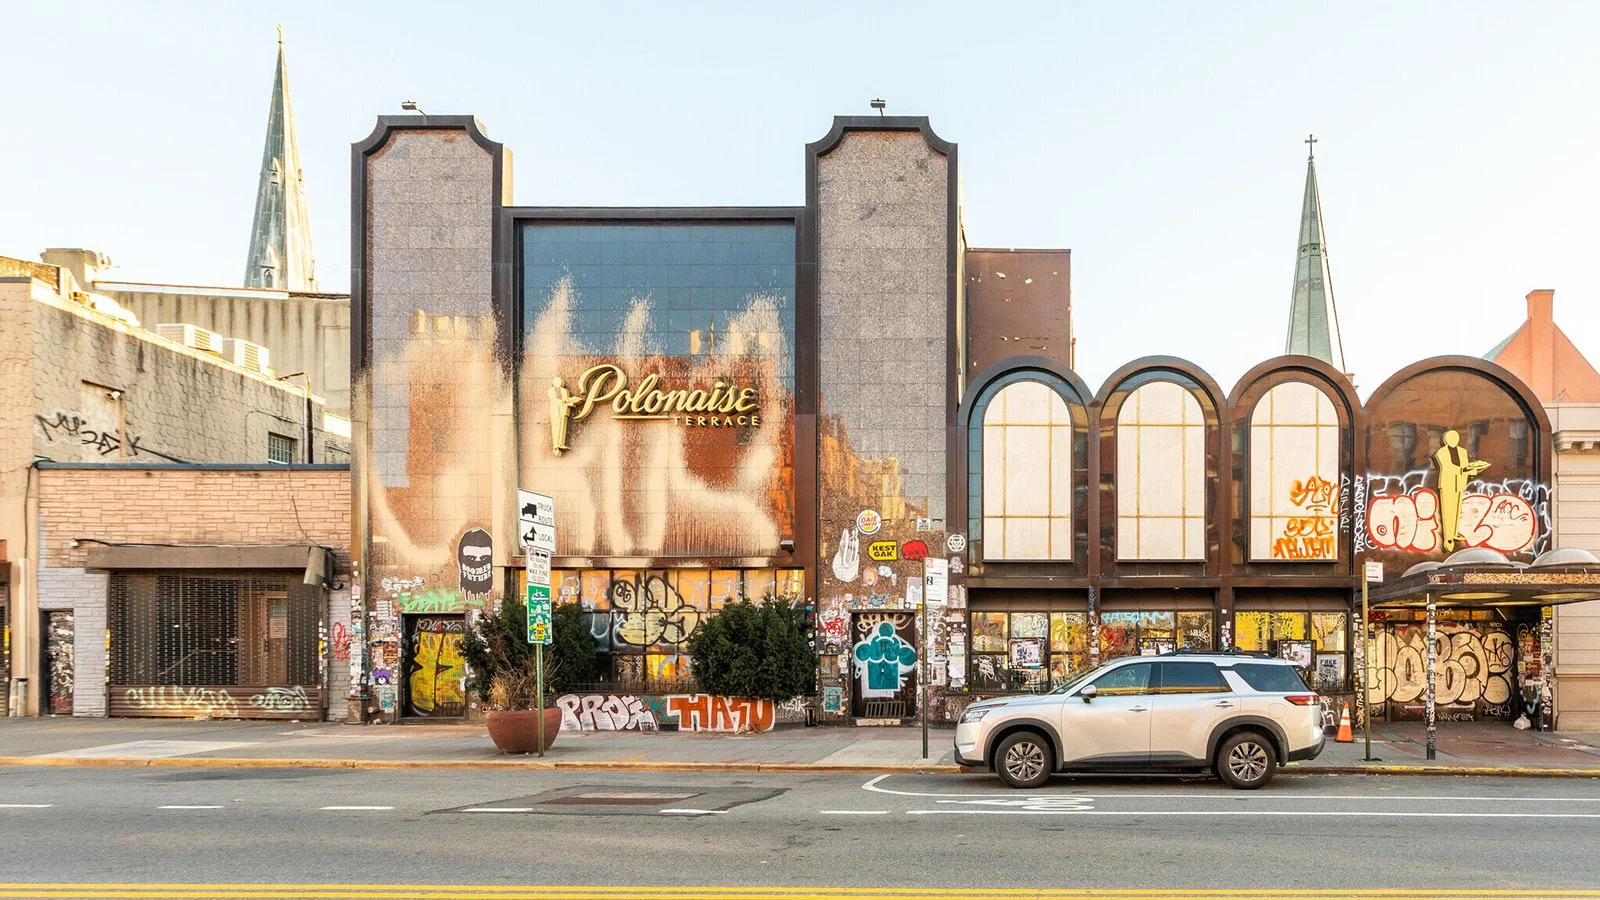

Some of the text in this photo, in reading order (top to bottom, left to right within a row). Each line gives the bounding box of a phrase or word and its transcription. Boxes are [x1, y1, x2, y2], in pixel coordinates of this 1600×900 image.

[573, 364, 761, 421] Polonaise
[674, 415, 760, 427] TERRACE
[538, 502, 552, 512] TRUCK
[538, 516, 553, 526] ROUTE
[538, 533, 553, 543] LOCAL
